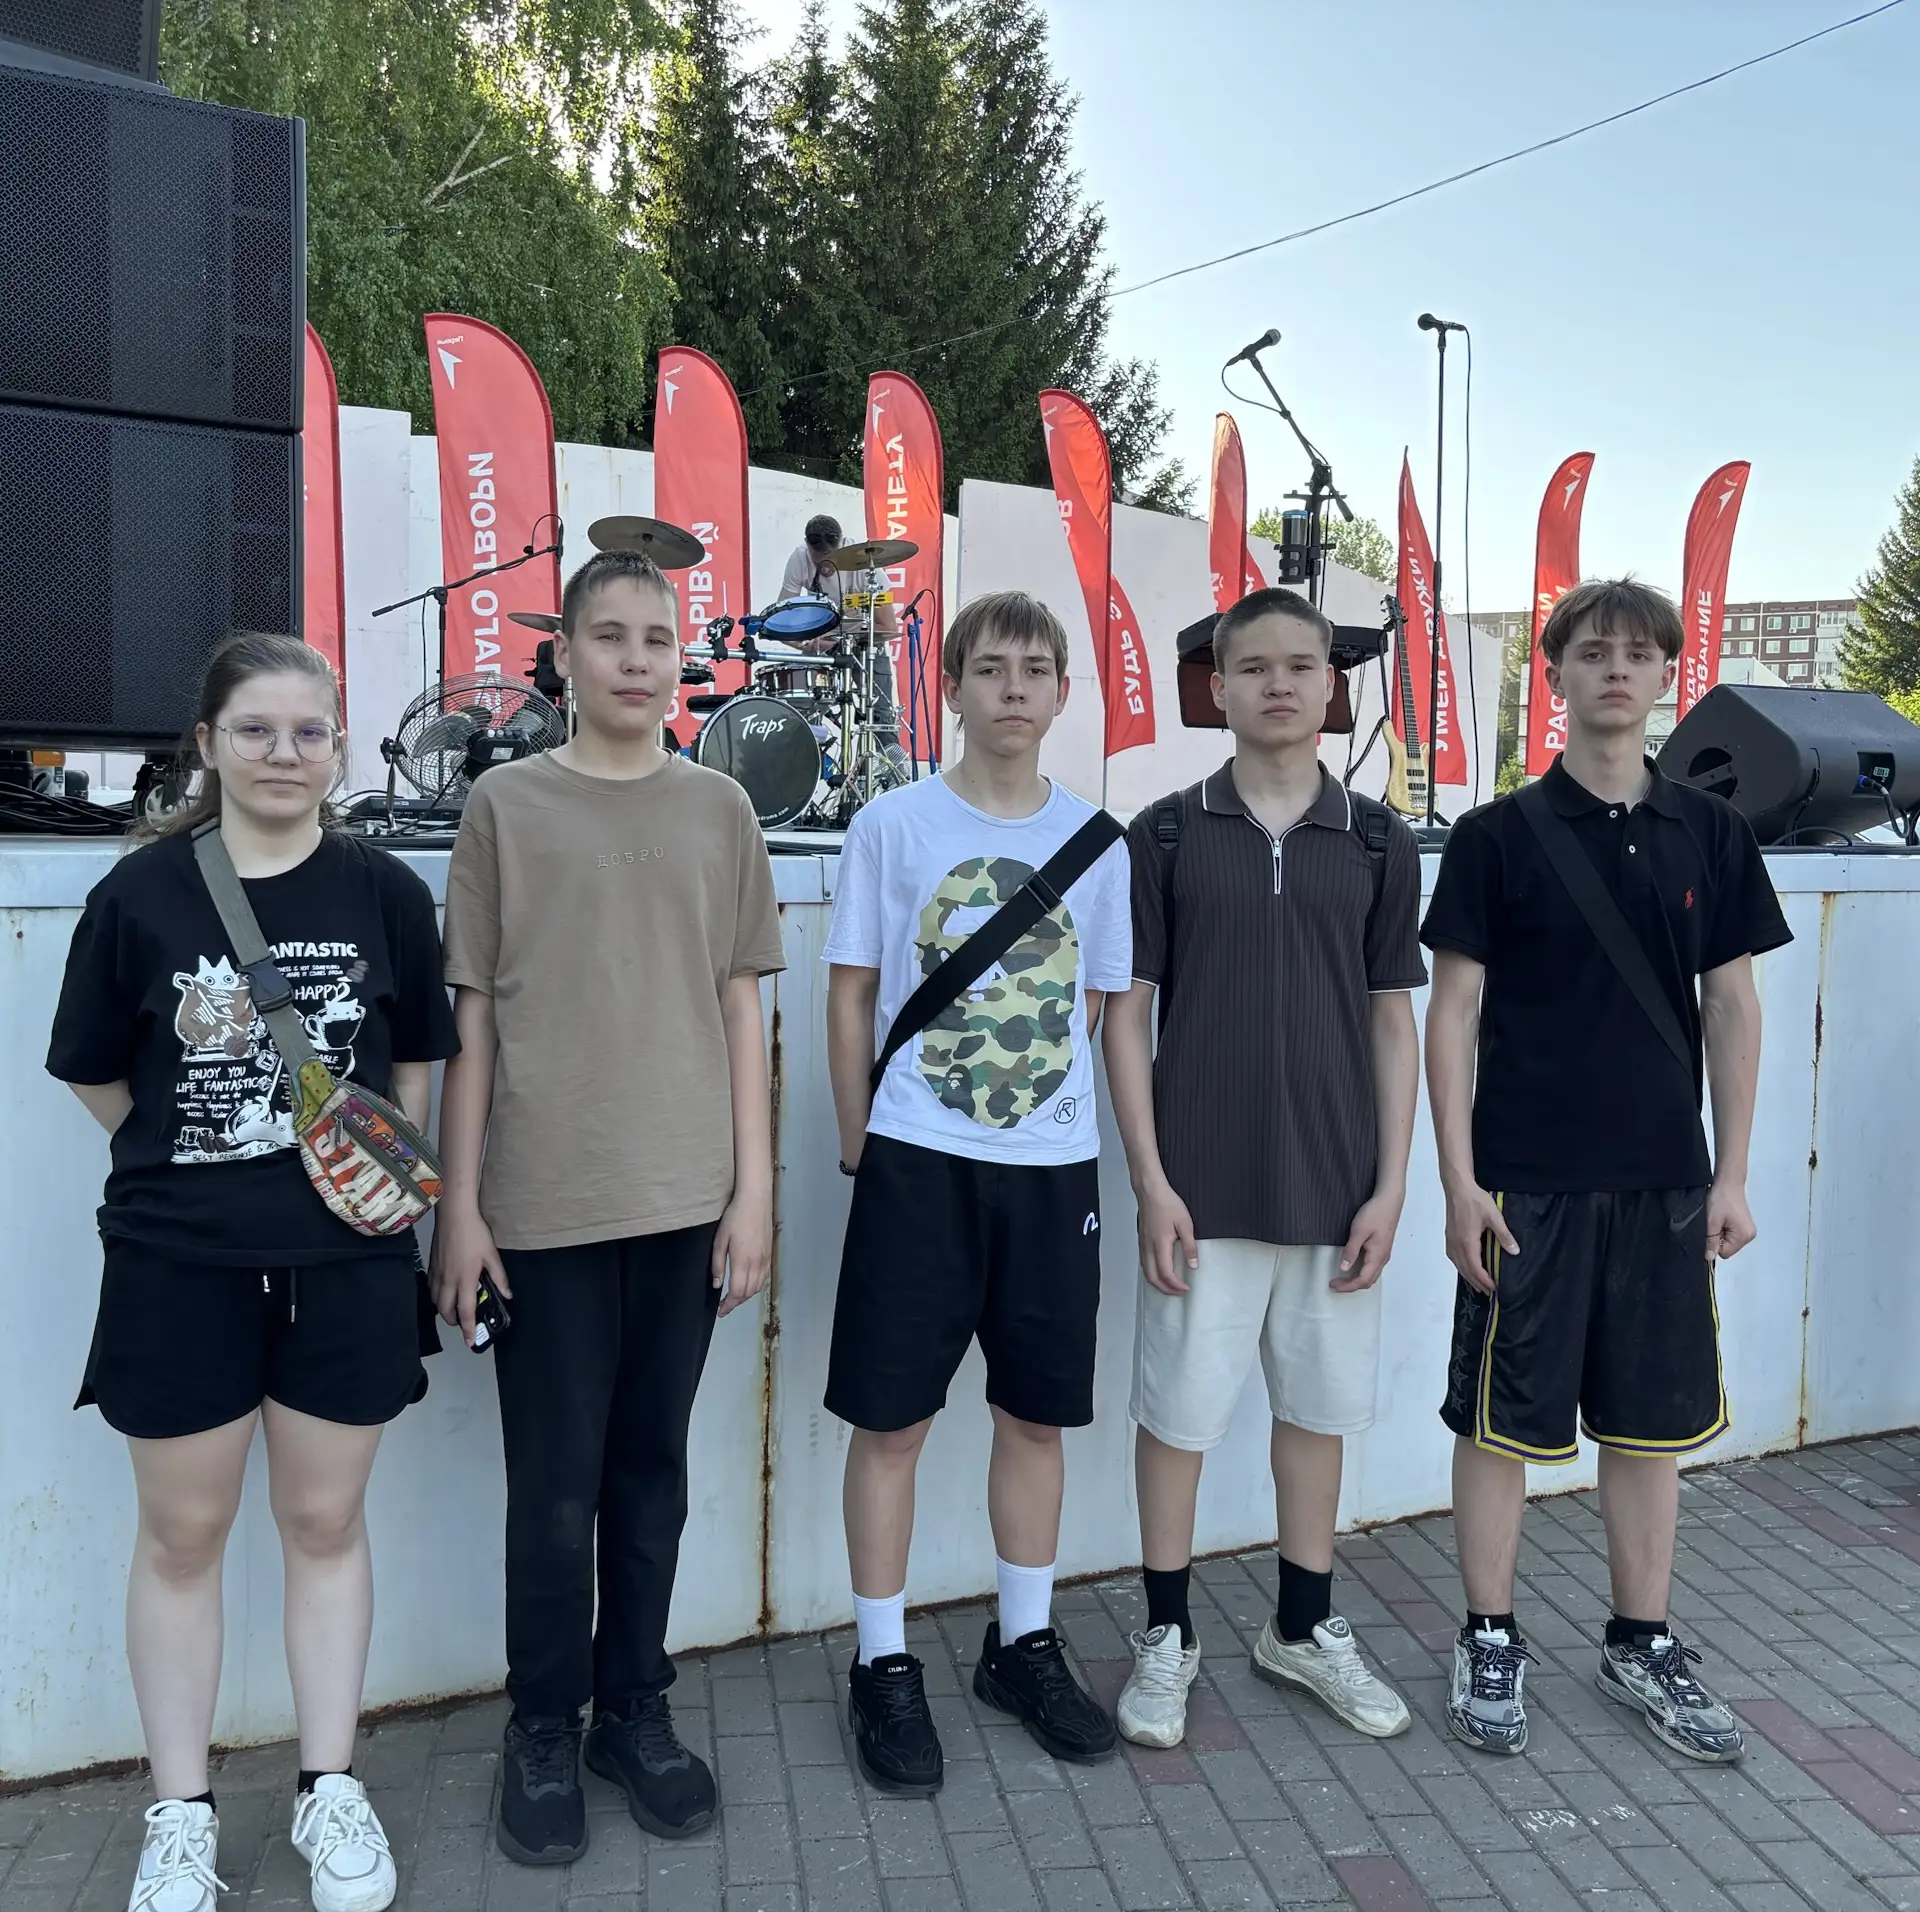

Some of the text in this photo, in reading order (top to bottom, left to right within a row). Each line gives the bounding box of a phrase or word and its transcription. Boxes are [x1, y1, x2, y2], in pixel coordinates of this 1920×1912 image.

[1120, 629, 1145, 716] БУДЬ
[739, 713, 788, 742] Traps
[596, 846, 664, 869] ДОБРО
[269, 941, 359, 959] ANTASTIC
[294, 983, 342, 1000] HAPPY
[188, 1065, 246, 1080] ENJOY YOU
[176, 1077, 259, 1093] LIFE FANTASTIC
[192, 1153, 213, 1162] BEST
[315, 1125, 423, 1232] START
